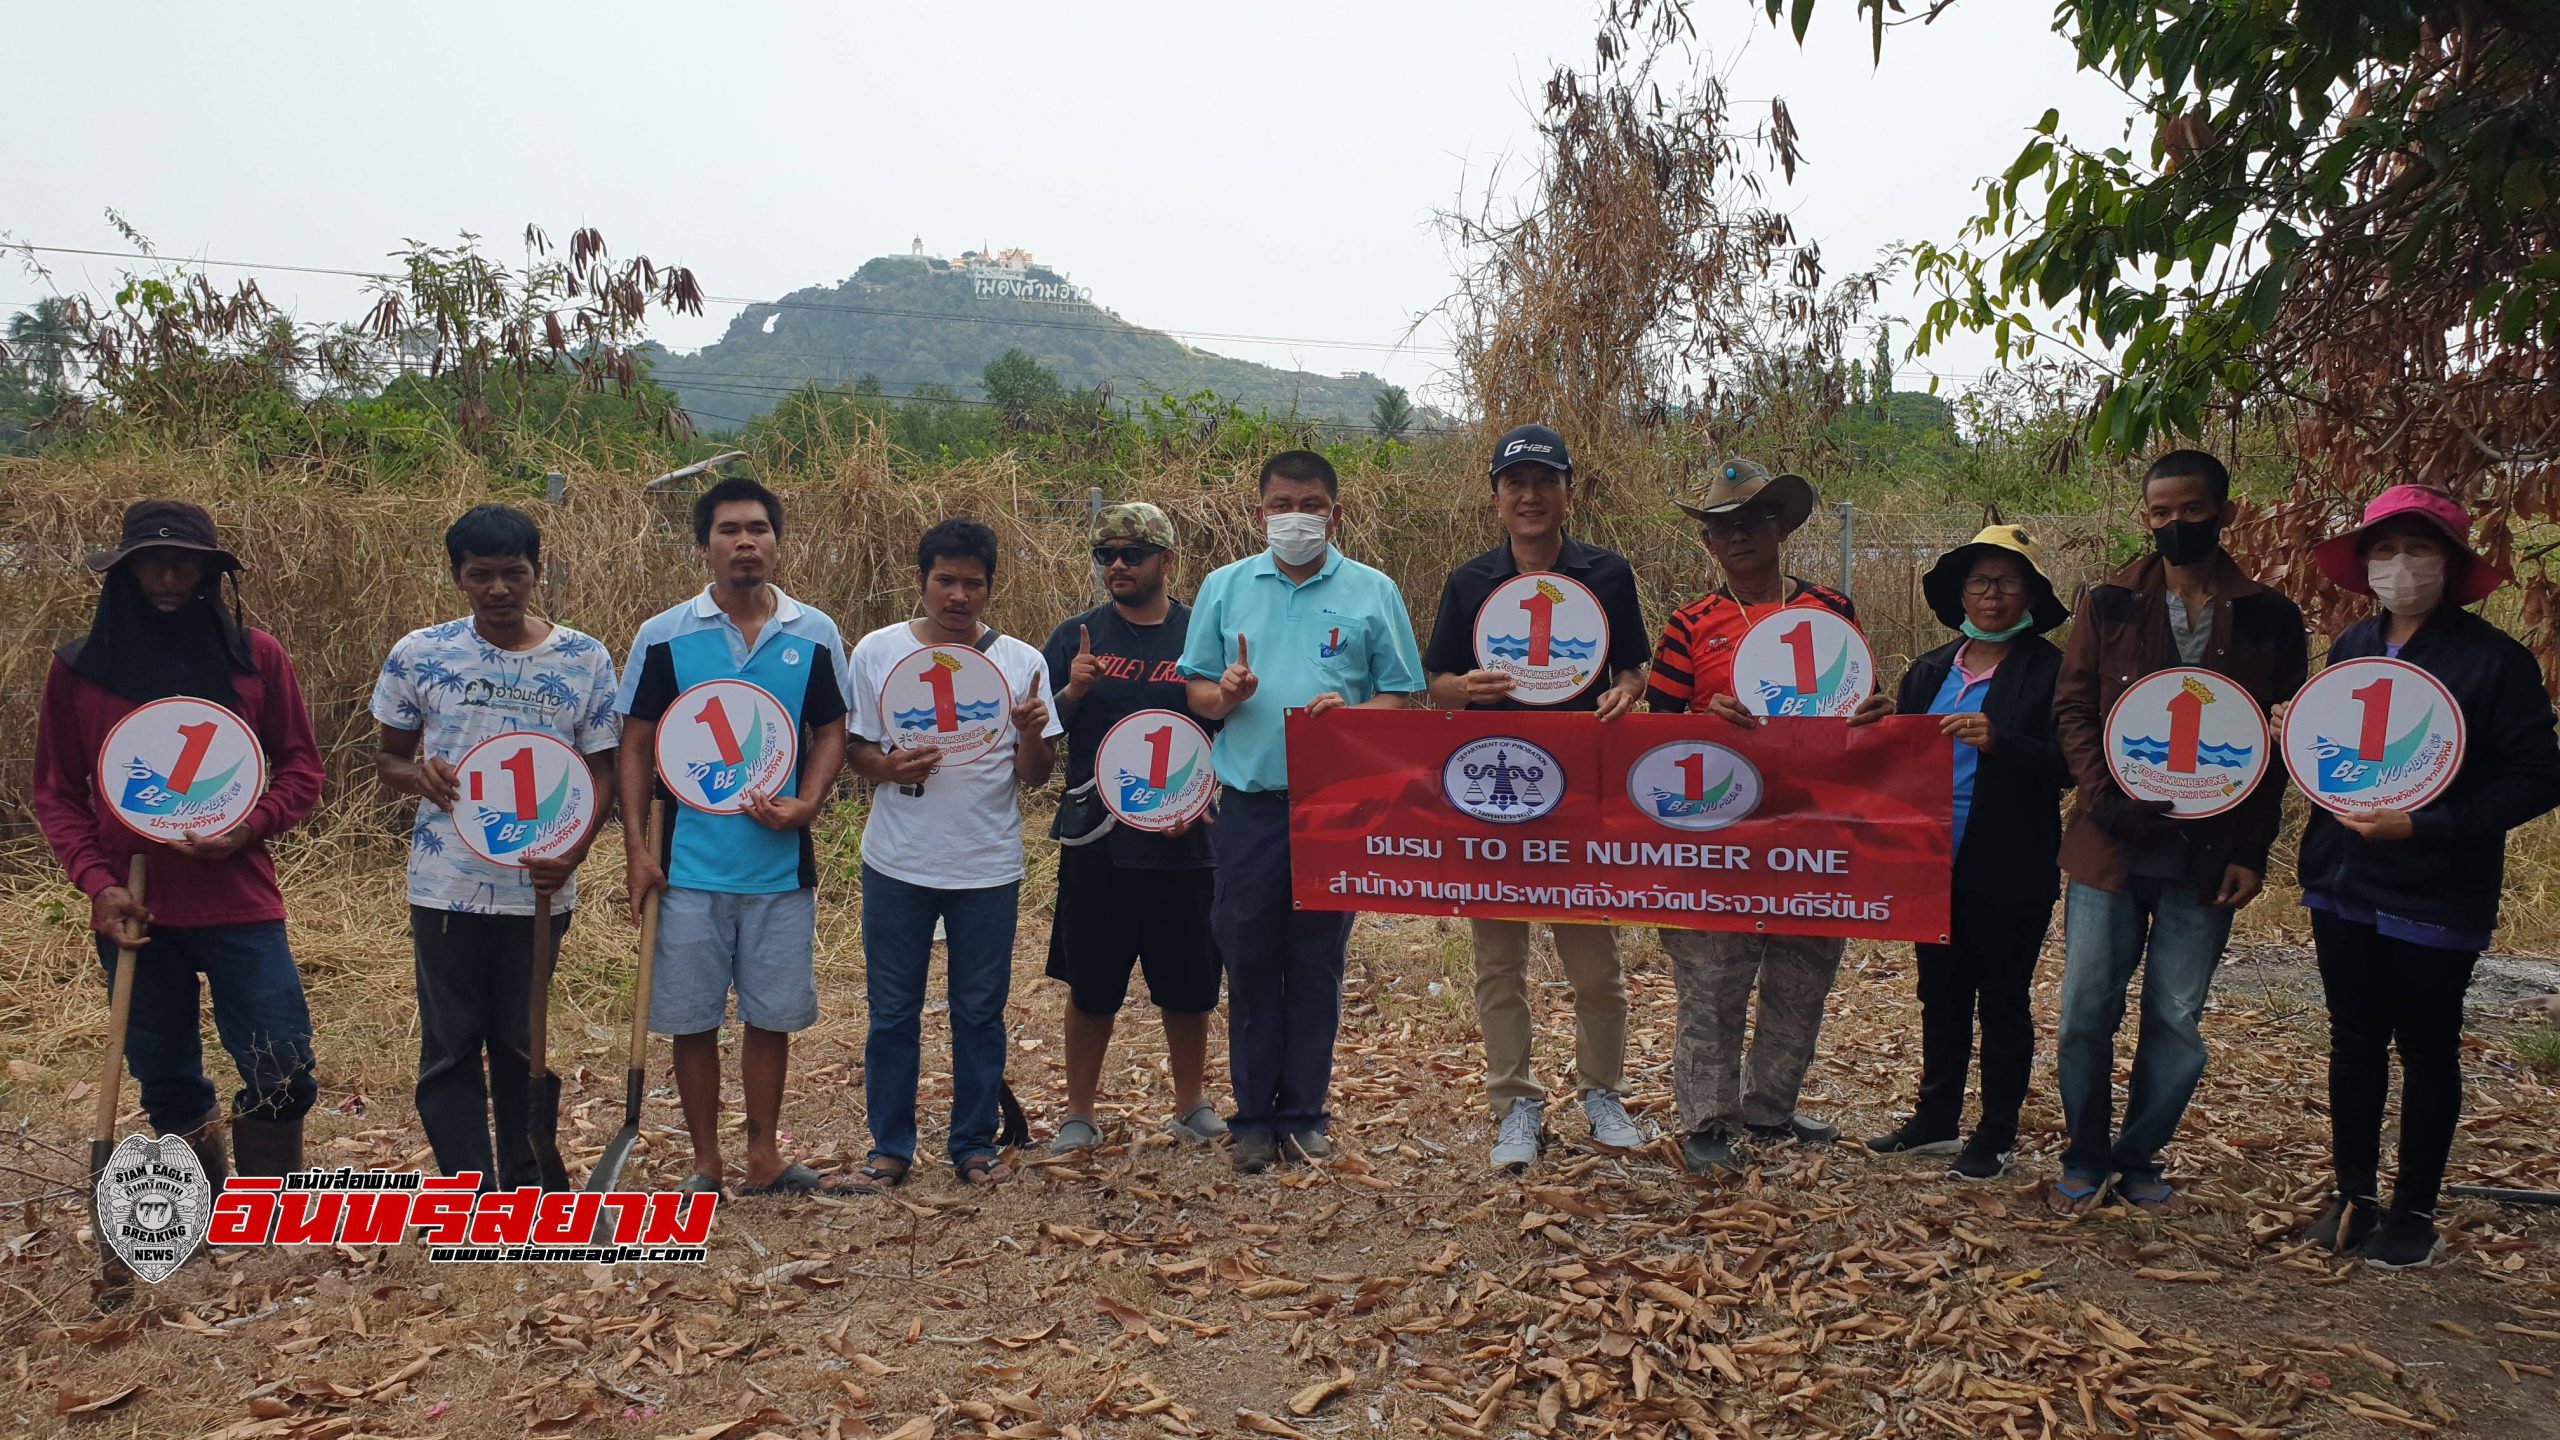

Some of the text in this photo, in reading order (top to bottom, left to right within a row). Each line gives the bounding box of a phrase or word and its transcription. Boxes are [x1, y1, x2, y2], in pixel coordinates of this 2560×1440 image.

[1504, 439, 1553, 457] G425
[1520, 592, 1553, 666] 1
[1501, 660, 1578, 680] TO BE NUMBER ONE
[1780, 621, 1817, 695] 1
[919, 663, 958, 733] 1
[1754, 680, 1782, 700] TO
[694, 695, 744, 767] 1
[2166, 690, 2202, 774] 1
[2352, 678, 2393, 762] 1
[912, 732, 924, 742] TO
[924, 735, 935, 744] BE
[936, 733, 970, 745] NUMBER
[1457, 741, 1499, 762] DEPARTMENT
[1512, 742, 1549, 767] PROBATION
[2307, 737, 2341, 760] TO
[121, 760, 153, 780] TO
[165, 721, 218, 795] 1
[685, 760, 711, 781] TO
[1144, 725, 1173, 789] 1
[501, 747, 538, 821] 1
[1113, 770, 1137, 787] TO
[1674, 753, 1703, 800] 1
[2138, 764, 2229, 788] TO BE NUMBER ONE
[472, 805, 502, 827] TO
[1668, 800, 1693, 813] BE
[1366, 835, 1849, 874] ชมรม TO BE NUMBER ONE
[1328, 871, 1894, 921] สำนักงานคุมประพฤติจังหวัดประจวบคีรีขันธ์
